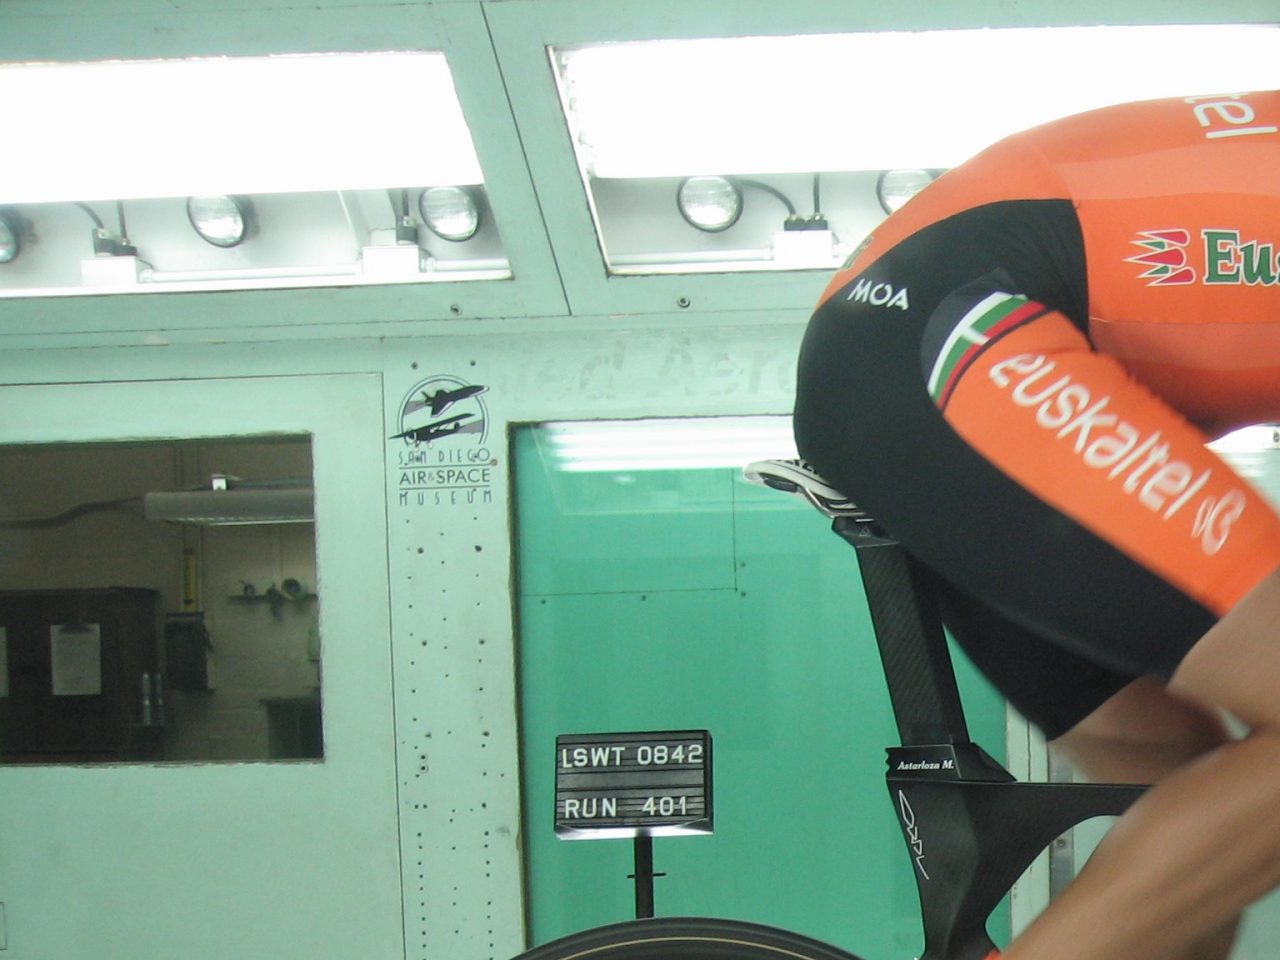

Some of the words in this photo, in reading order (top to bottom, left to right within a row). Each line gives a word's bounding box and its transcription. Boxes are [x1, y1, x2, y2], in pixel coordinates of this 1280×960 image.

[847, 278, 909, 311] MOA
[988, 353, 1212, 521] euskaltel
[399, 450, 427, 465] SAN
[438, 447, 490, 463] DIEGO
[399, 489, 492, 506] MUSEUM
[562, 746, 626, 768] LSWT
[637, 744, 703, 765] 0842
[942, 759, 955, 769] M.
[564, 798, 617, 818] RUN
[642, 796, 688, 815] 401
